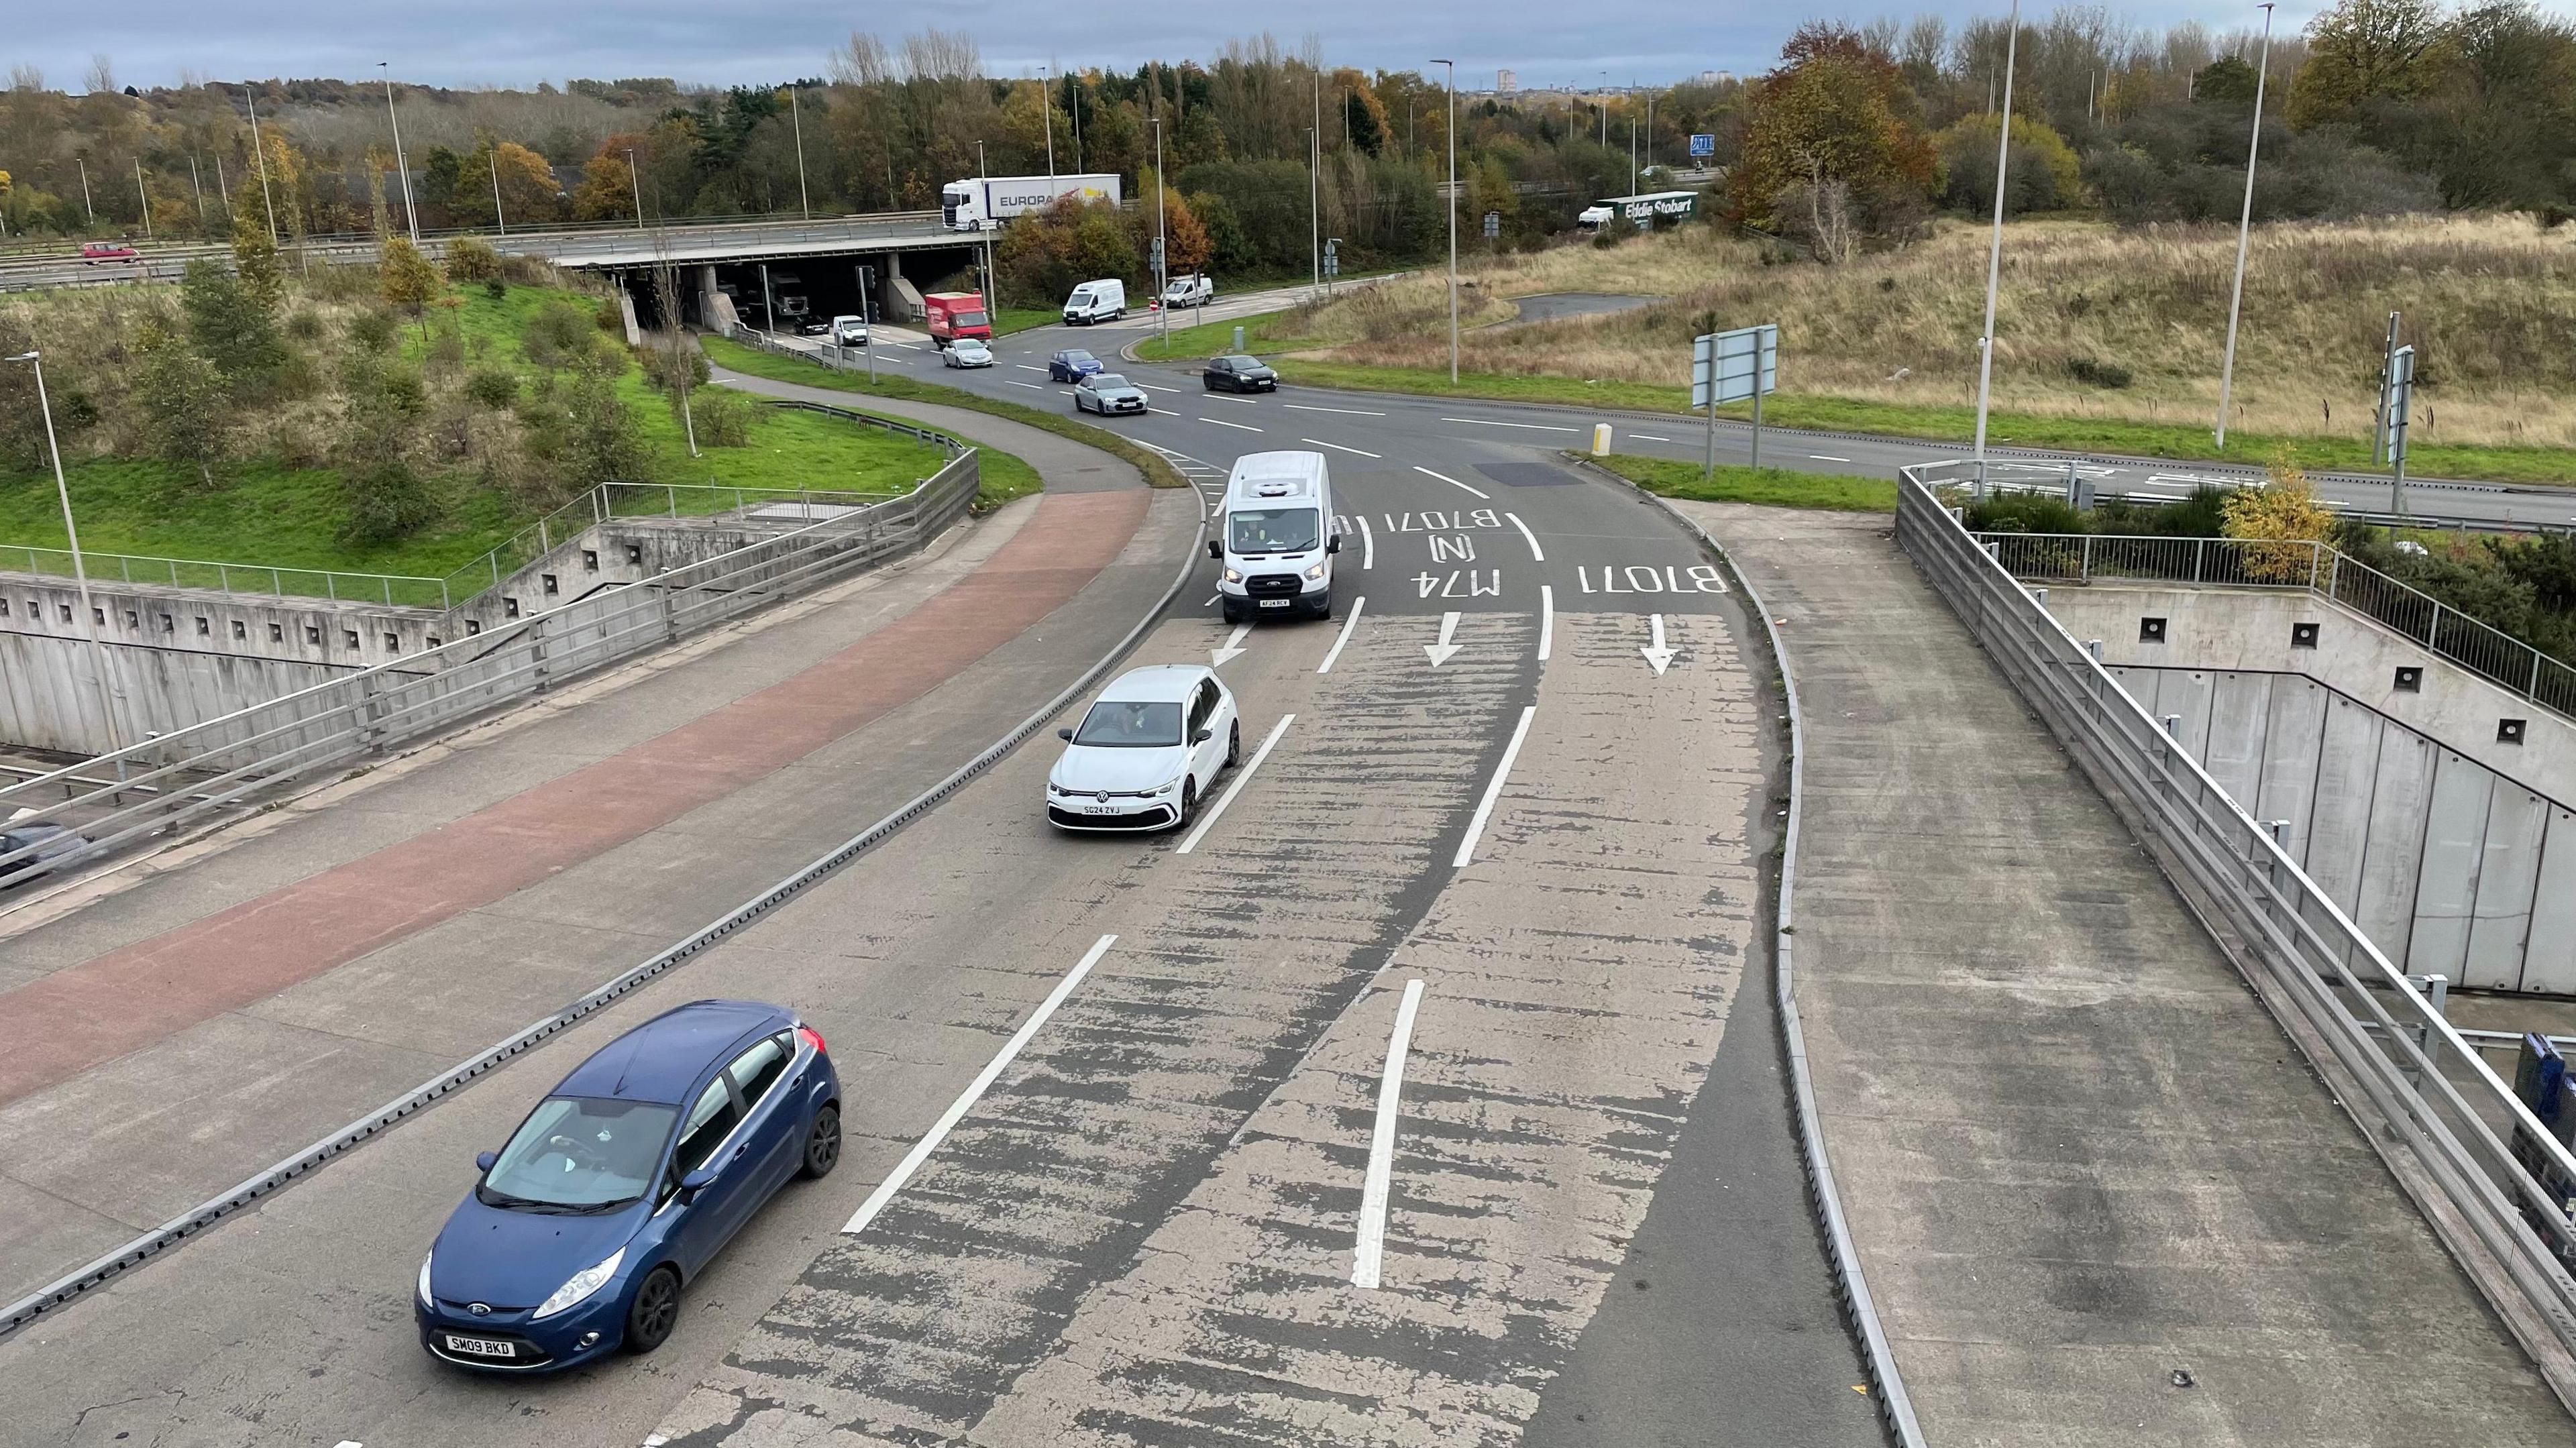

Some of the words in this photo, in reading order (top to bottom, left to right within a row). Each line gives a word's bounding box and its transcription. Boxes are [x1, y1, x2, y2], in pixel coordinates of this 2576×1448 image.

[1000, 195, 1053, 207] EUROPA
[1625, 202, 1654, 219] Eddie
[1654, 199, 1692, 214] Stobart
[1384, 508, 1502, 532] B7071
[1410, 569, 1500, 598] M74
[1578, 565, 1730, 594] B7071
[451, 1338, 482, 1352] SM09
[484, 1342, 509, 1354] BKD
